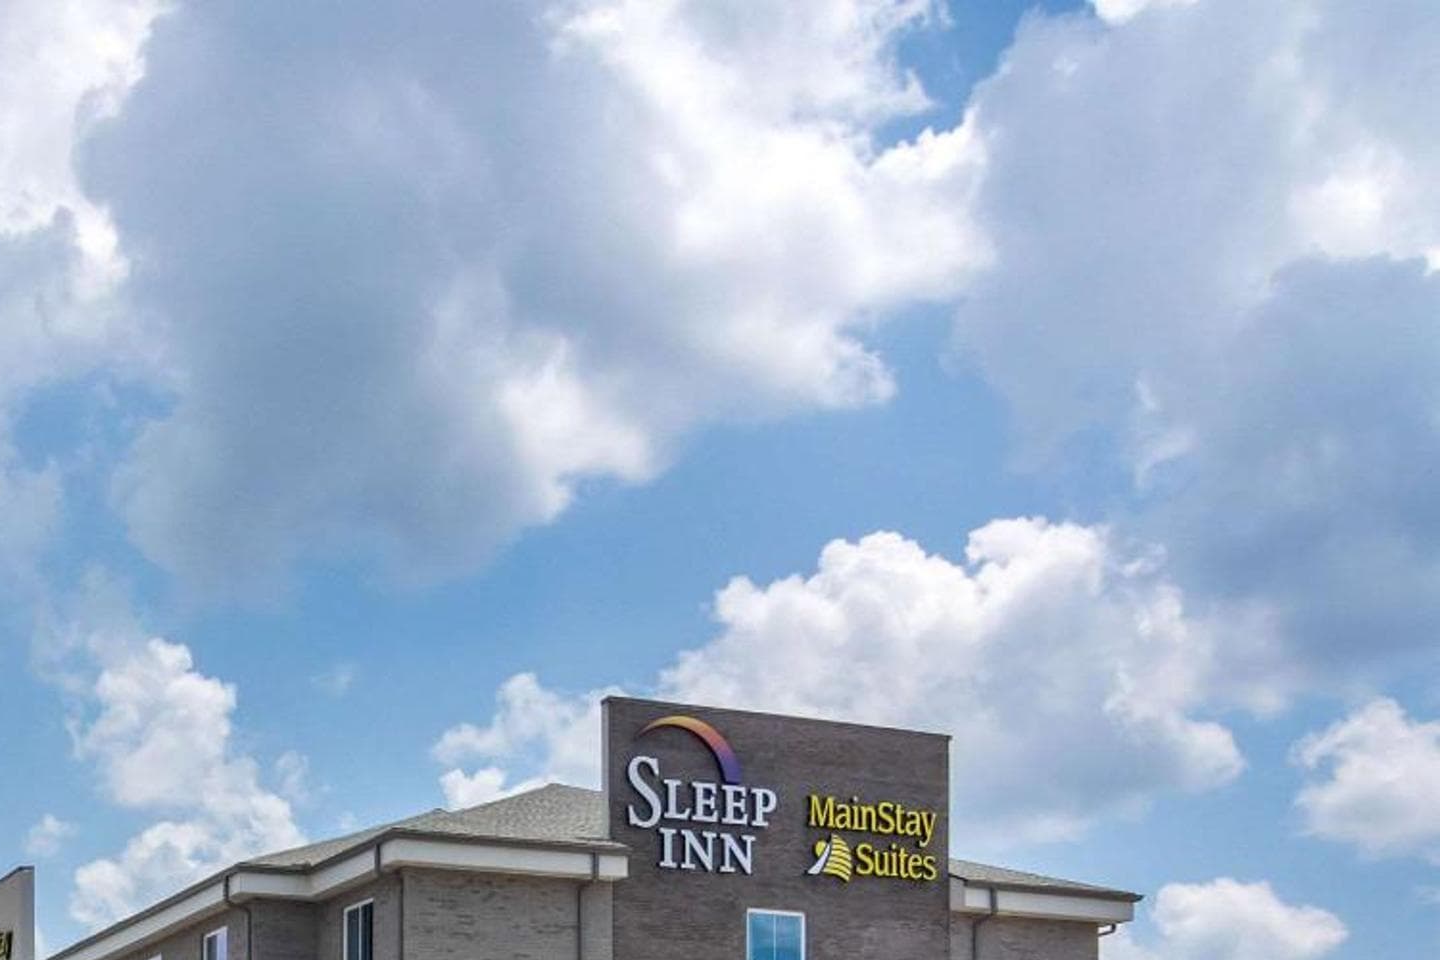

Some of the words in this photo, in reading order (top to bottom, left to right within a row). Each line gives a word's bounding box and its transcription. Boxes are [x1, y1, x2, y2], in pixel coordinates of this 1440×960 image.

[627, 756, 777, 828] SLEEP
[809, 794, 937, 847] MainStay
[657, 828, 756, 875] INN
[855, 843, 937, 881] Suites
